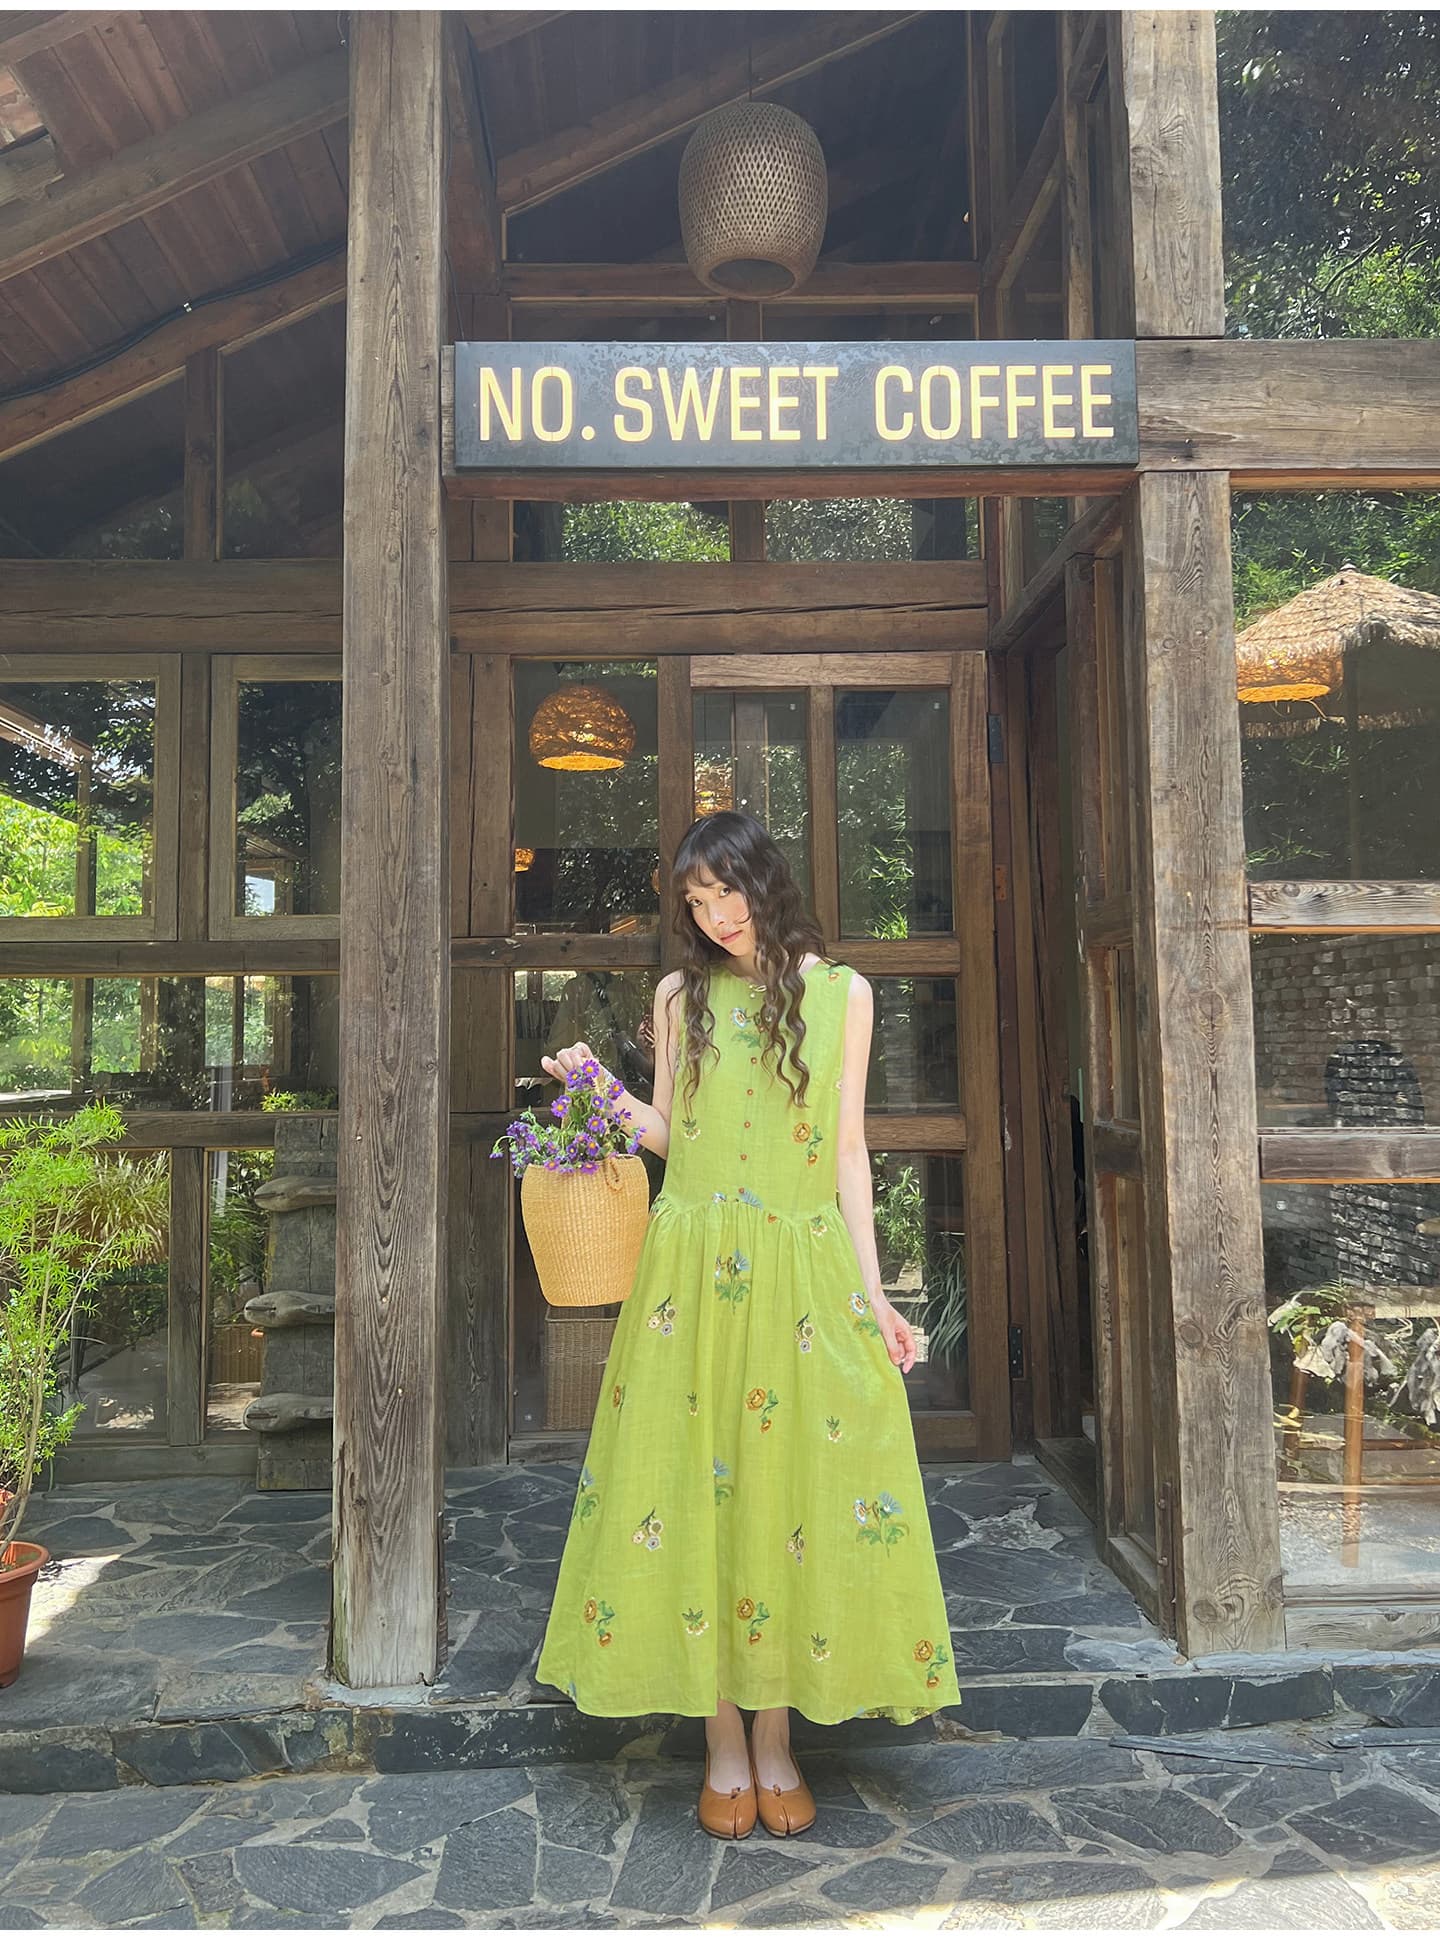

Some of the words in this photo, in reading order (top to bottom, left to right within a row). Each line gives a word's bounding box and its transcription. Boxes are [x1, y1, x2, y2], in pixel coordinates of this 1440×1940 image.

[478, 366, 596, 442] NO.
[613, 365, 840, 443] SWEET
[874, 364, 1115, 440] COFFEE
